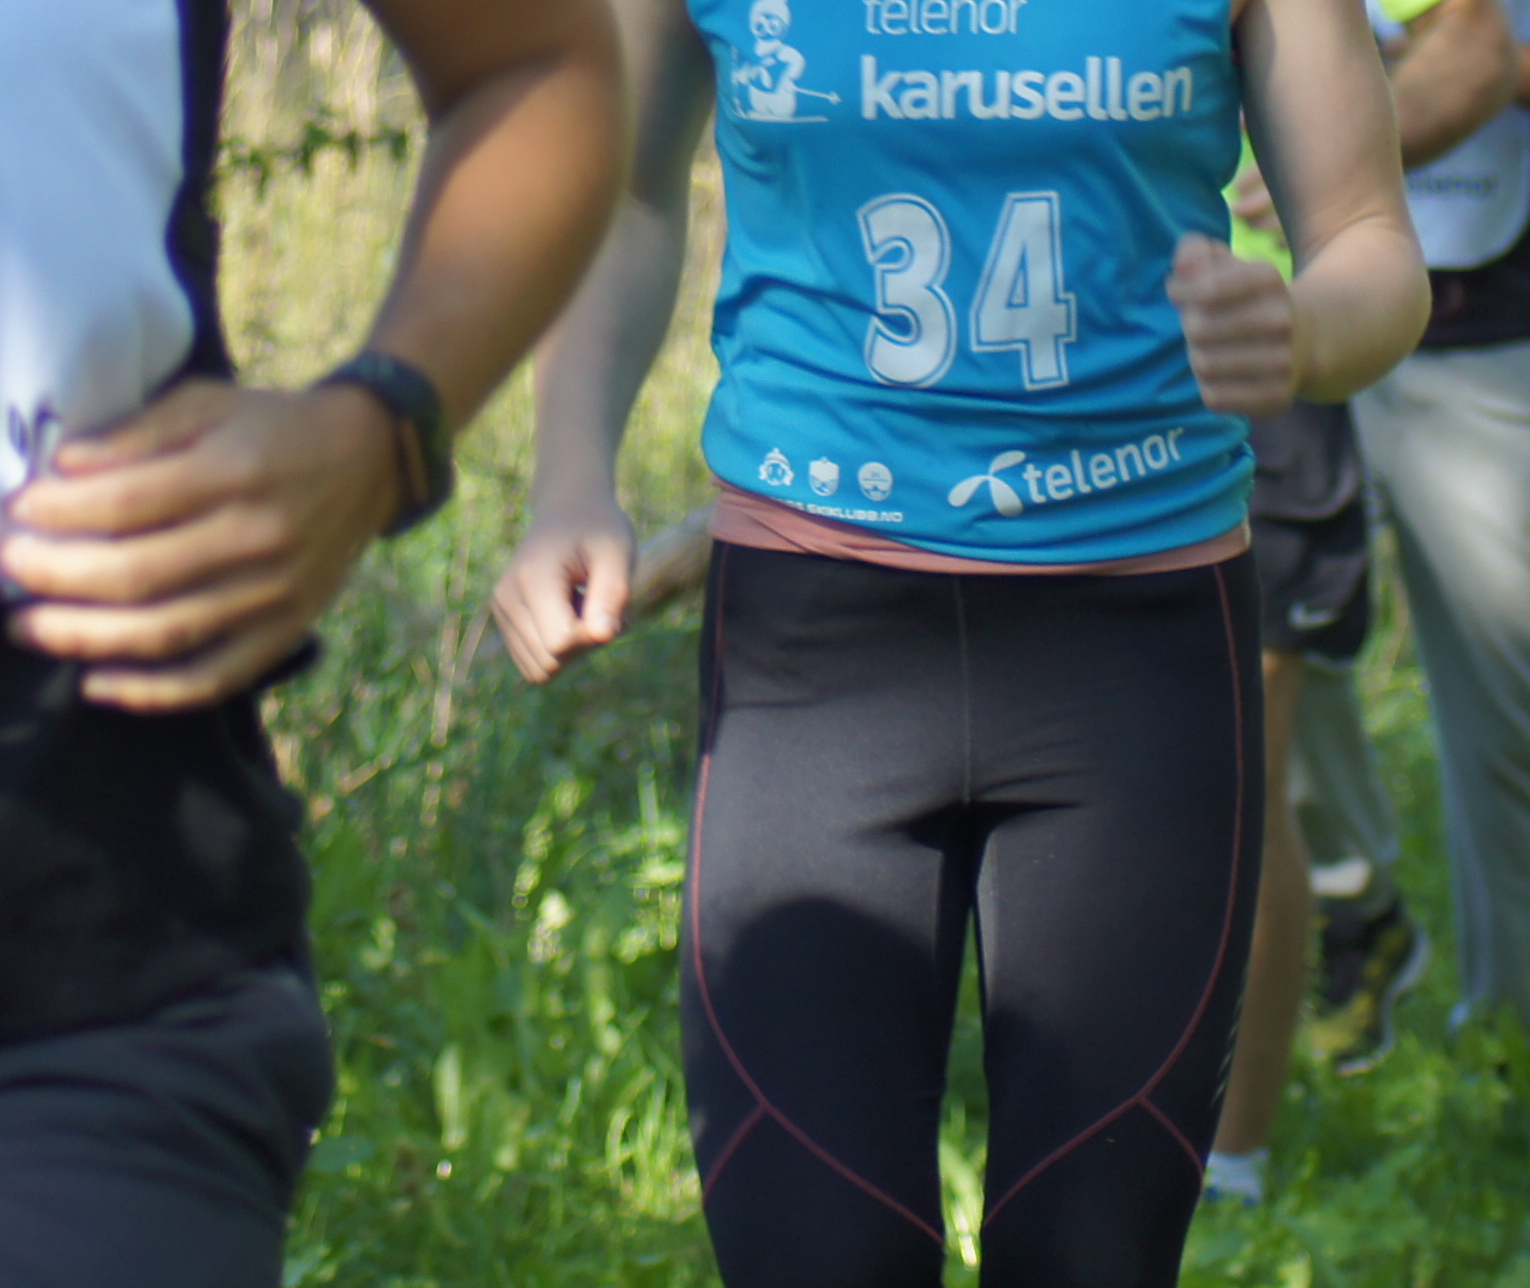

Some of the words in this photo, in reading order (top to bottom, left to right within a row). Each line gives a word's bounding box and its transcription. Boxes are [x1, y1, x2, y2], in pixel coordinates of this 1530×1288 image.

[860, 55, 1192, 122] karusellen
[856, 191, 1076, 391] 34
[1023, 427, 1183, 505] telenor
